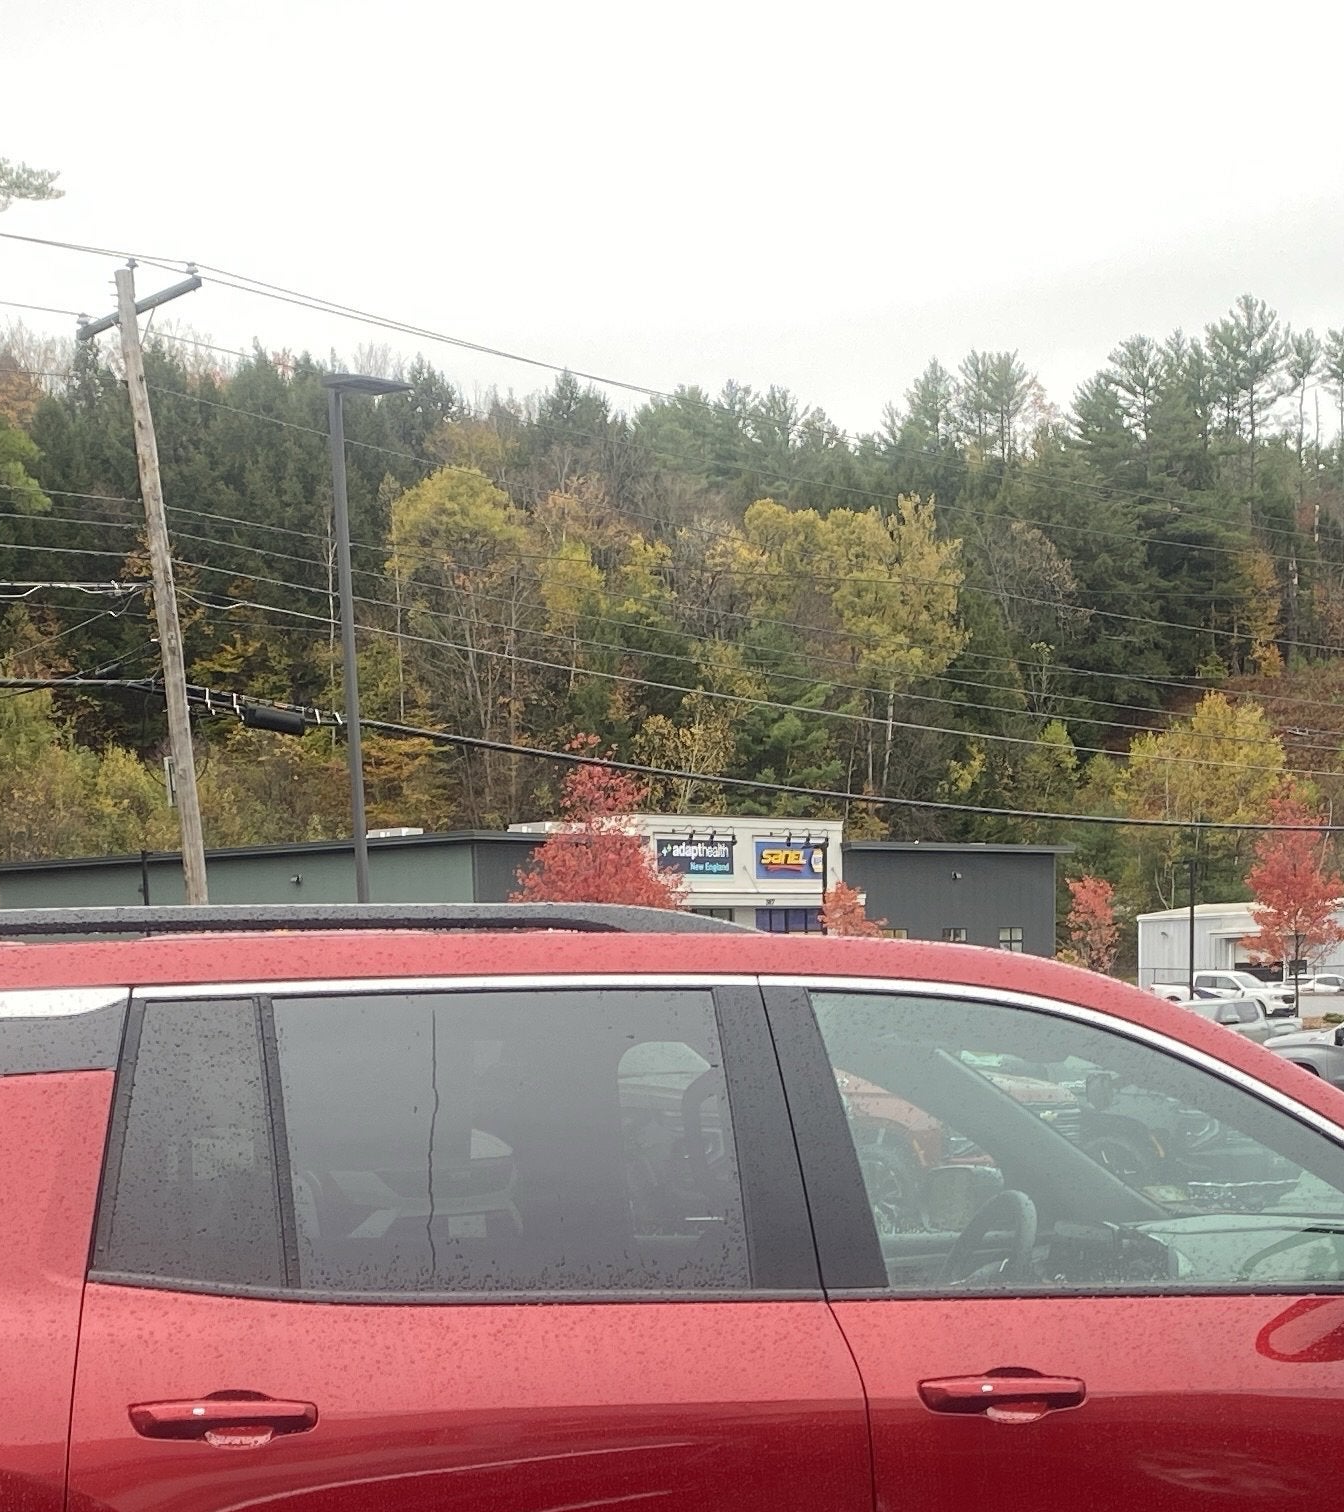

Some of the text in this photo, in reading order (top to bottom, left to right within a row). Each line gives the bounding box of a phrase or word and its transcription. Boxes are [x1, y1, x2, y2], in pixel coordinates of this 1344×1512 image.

[672, 842, 730, 860] adapthealth
[689, 861, 730, 873] New England
